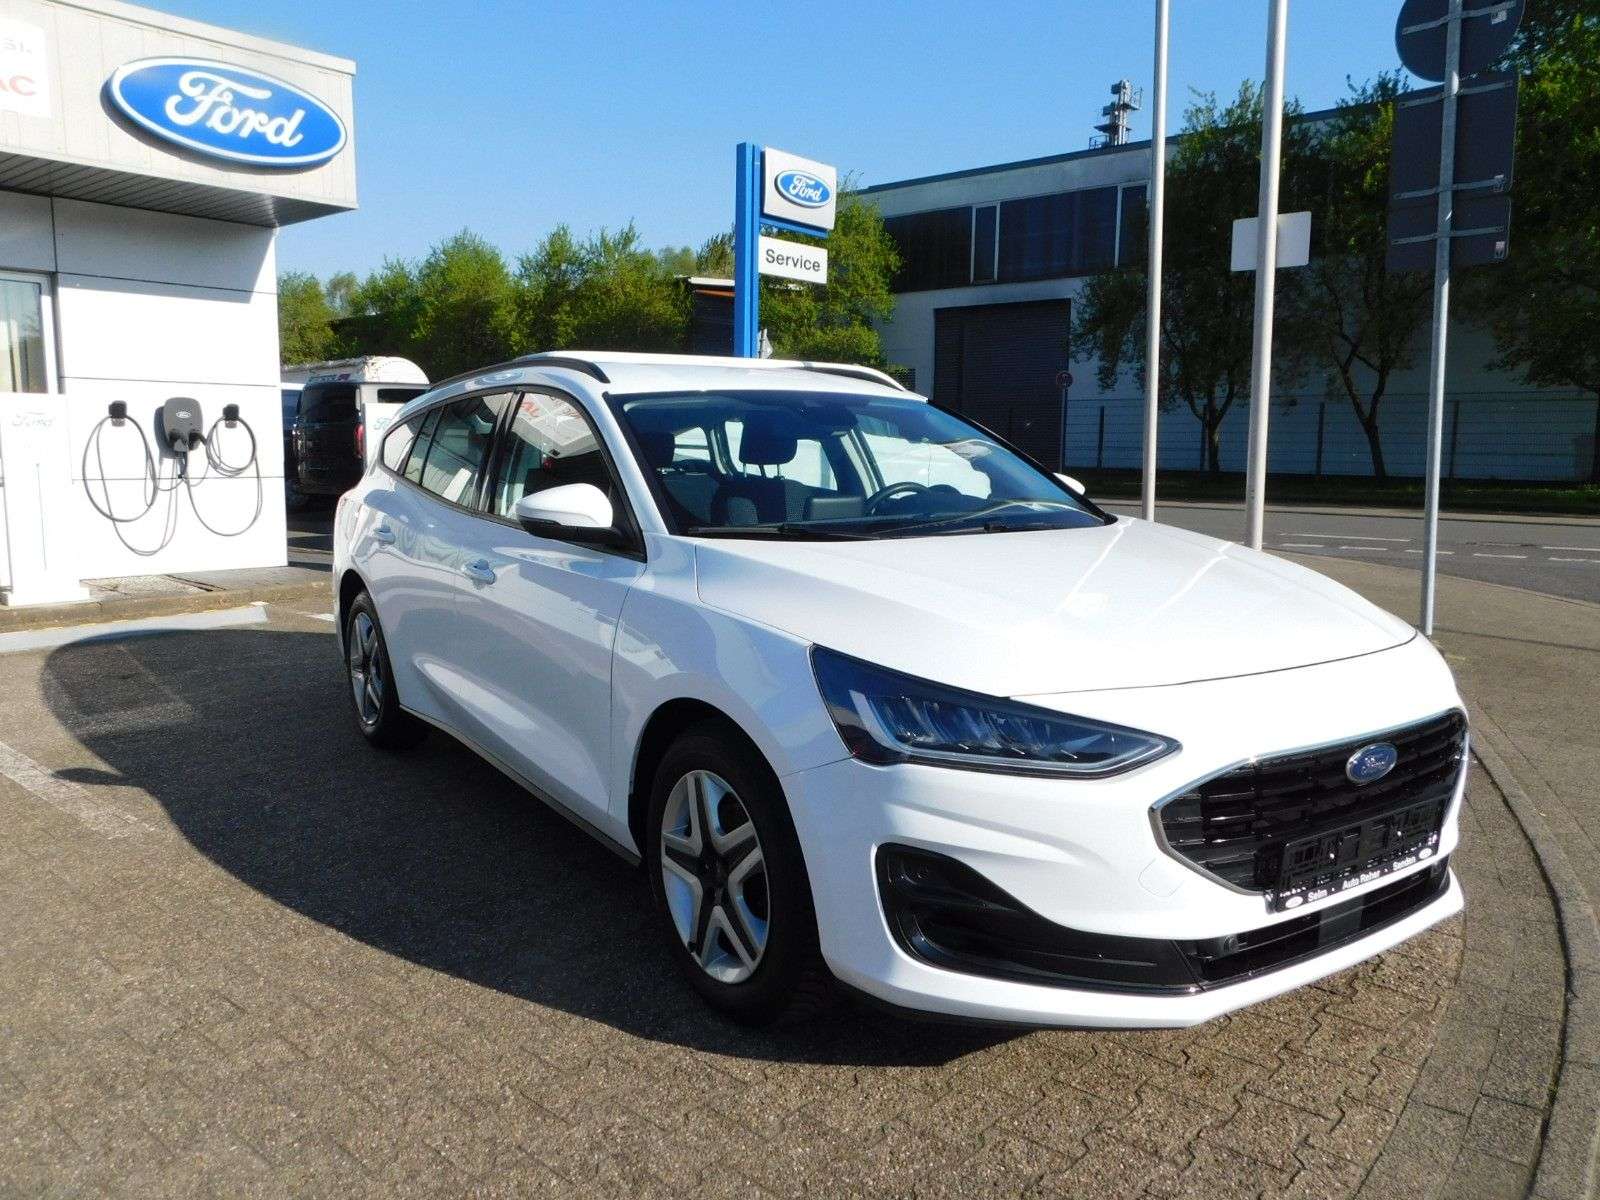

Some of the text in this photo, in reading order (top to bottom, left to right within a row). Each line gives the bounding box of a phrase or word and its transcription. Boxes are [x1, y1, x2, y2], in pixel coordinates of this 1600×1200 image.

[164, 71, 306, 148] Ford
[789, 174, 823, 202] Ford
[765, 248, 821, 272] Service
[1342, 877, 1360, 891] Auto
